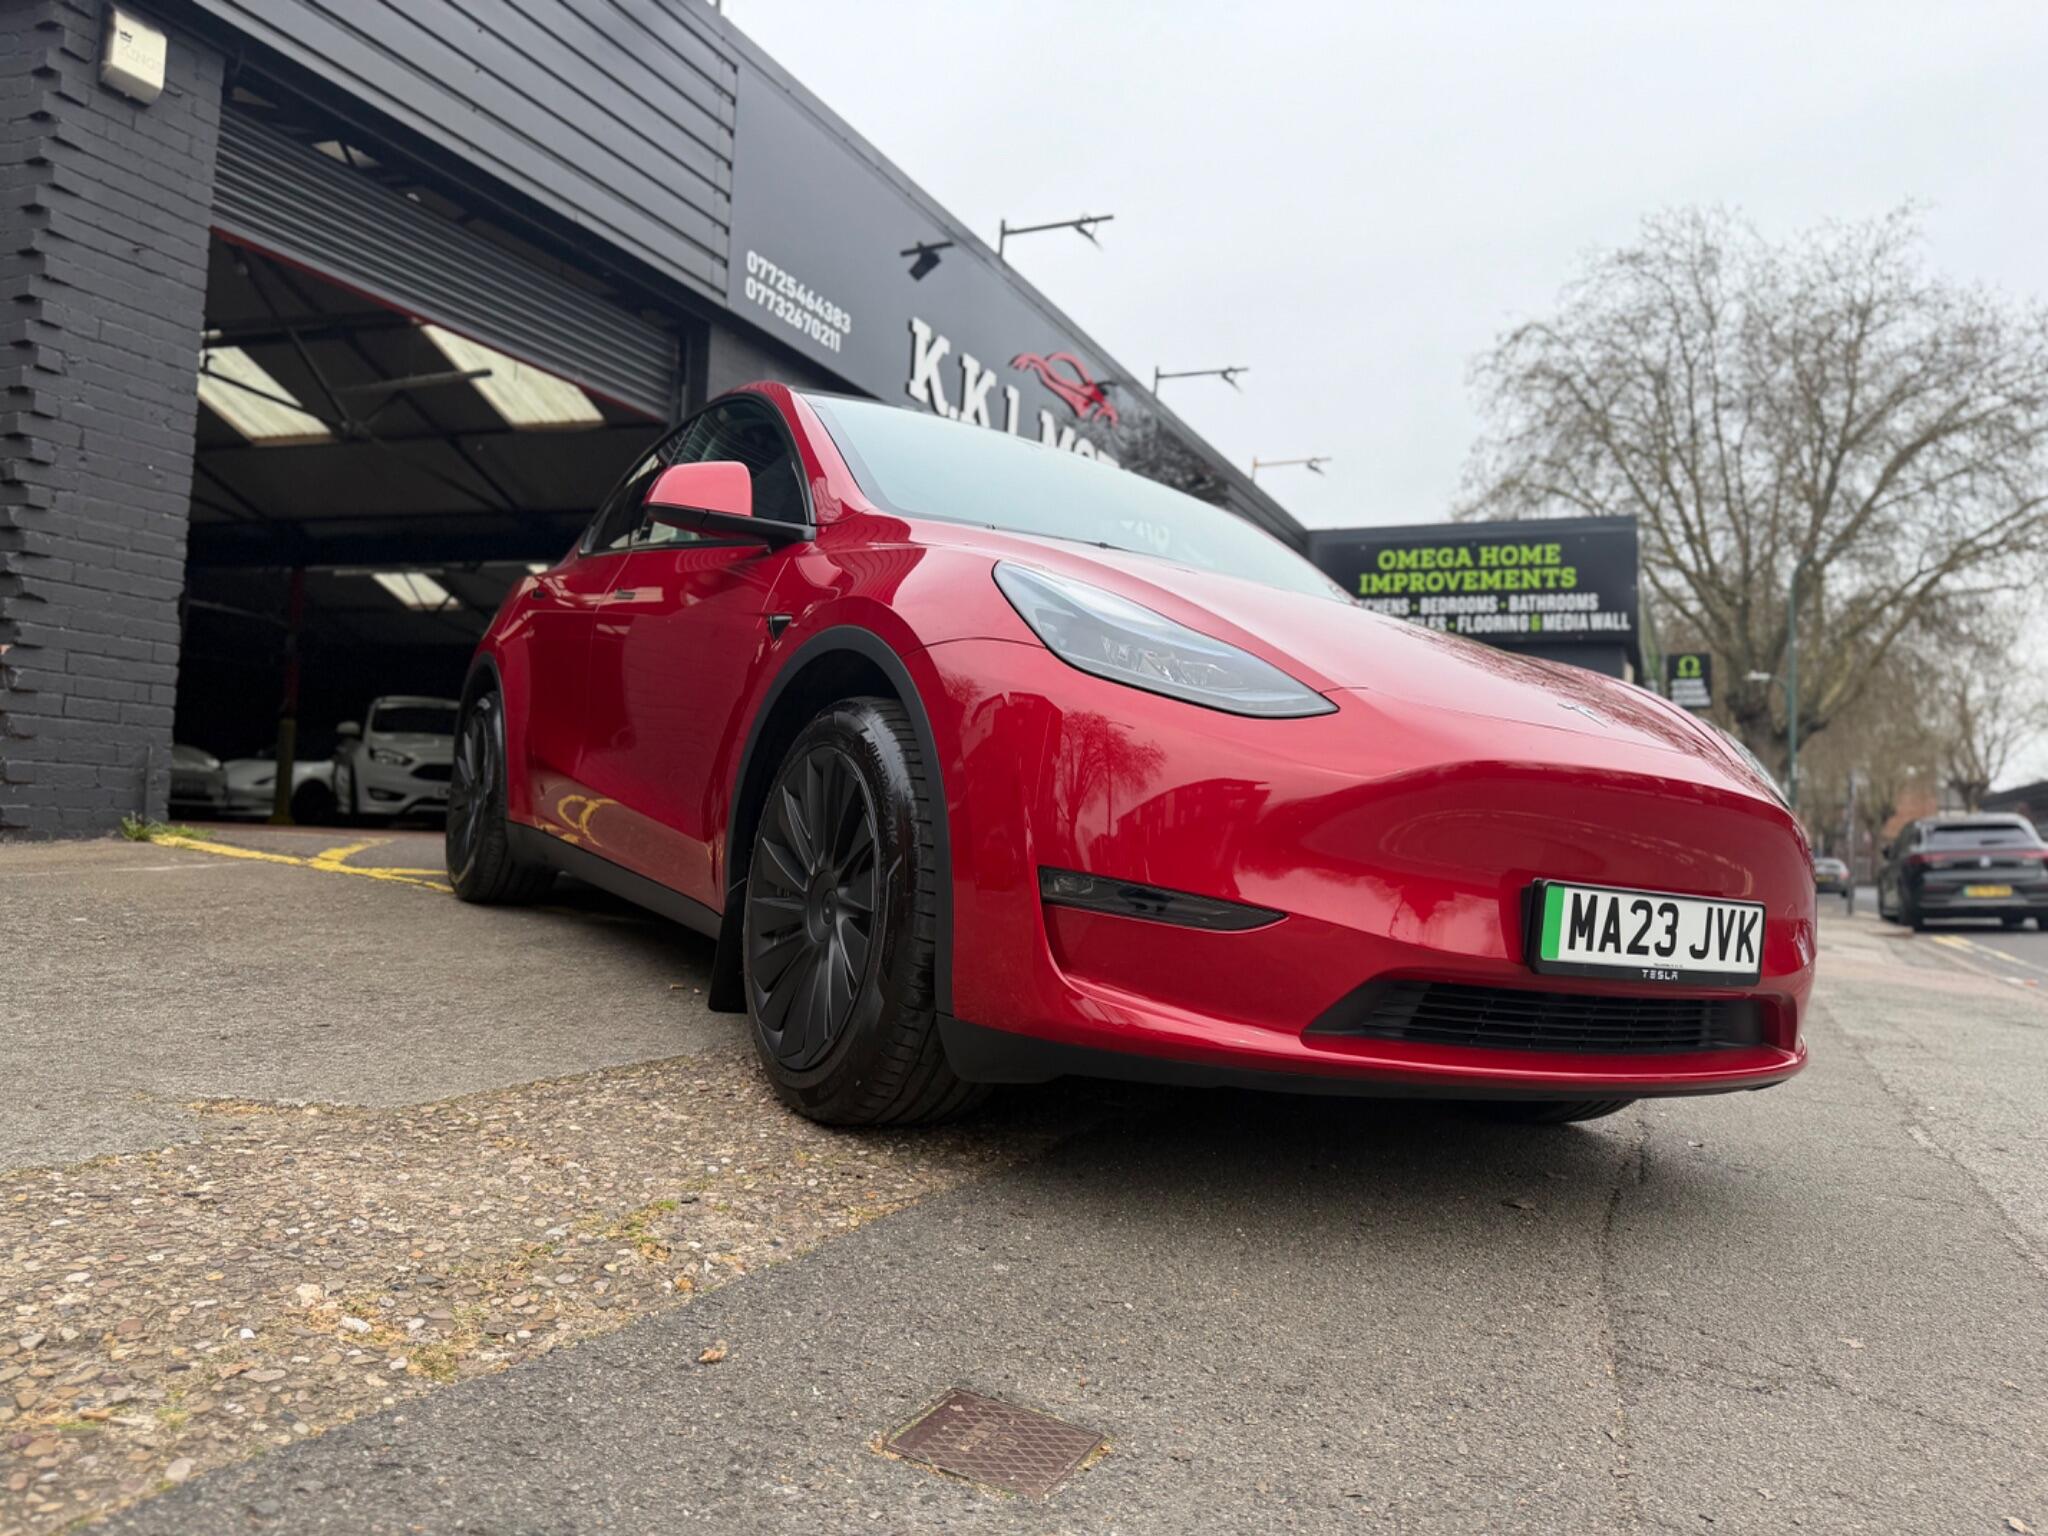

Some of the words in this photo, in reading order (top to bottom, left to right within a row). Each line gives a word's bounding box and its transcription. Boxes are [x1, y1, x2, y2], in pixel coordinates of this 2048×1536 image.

[745, 276, 841, 353] 07732670211
[1377, 547, 1474, 571] OMEGA
[1479, 543, 1562, 567] HOME
[1359, 567, 1578, 595] IMPROVEMENTS
[1420, 596, 1498, 615] BEDROOMS
[1508, 592, 1599, 613] BATHROOMS
[1456, 613, 1530, 633] FLOORING
[1542, 612, 1589, 632] MEDIA
[1589, 611, 1631, 631] WALL
[1568, 893, 1679, 957] MA23
[1689, 906, 1759, 963] JVK
[1642, 969, 1678, 980] TESLA
